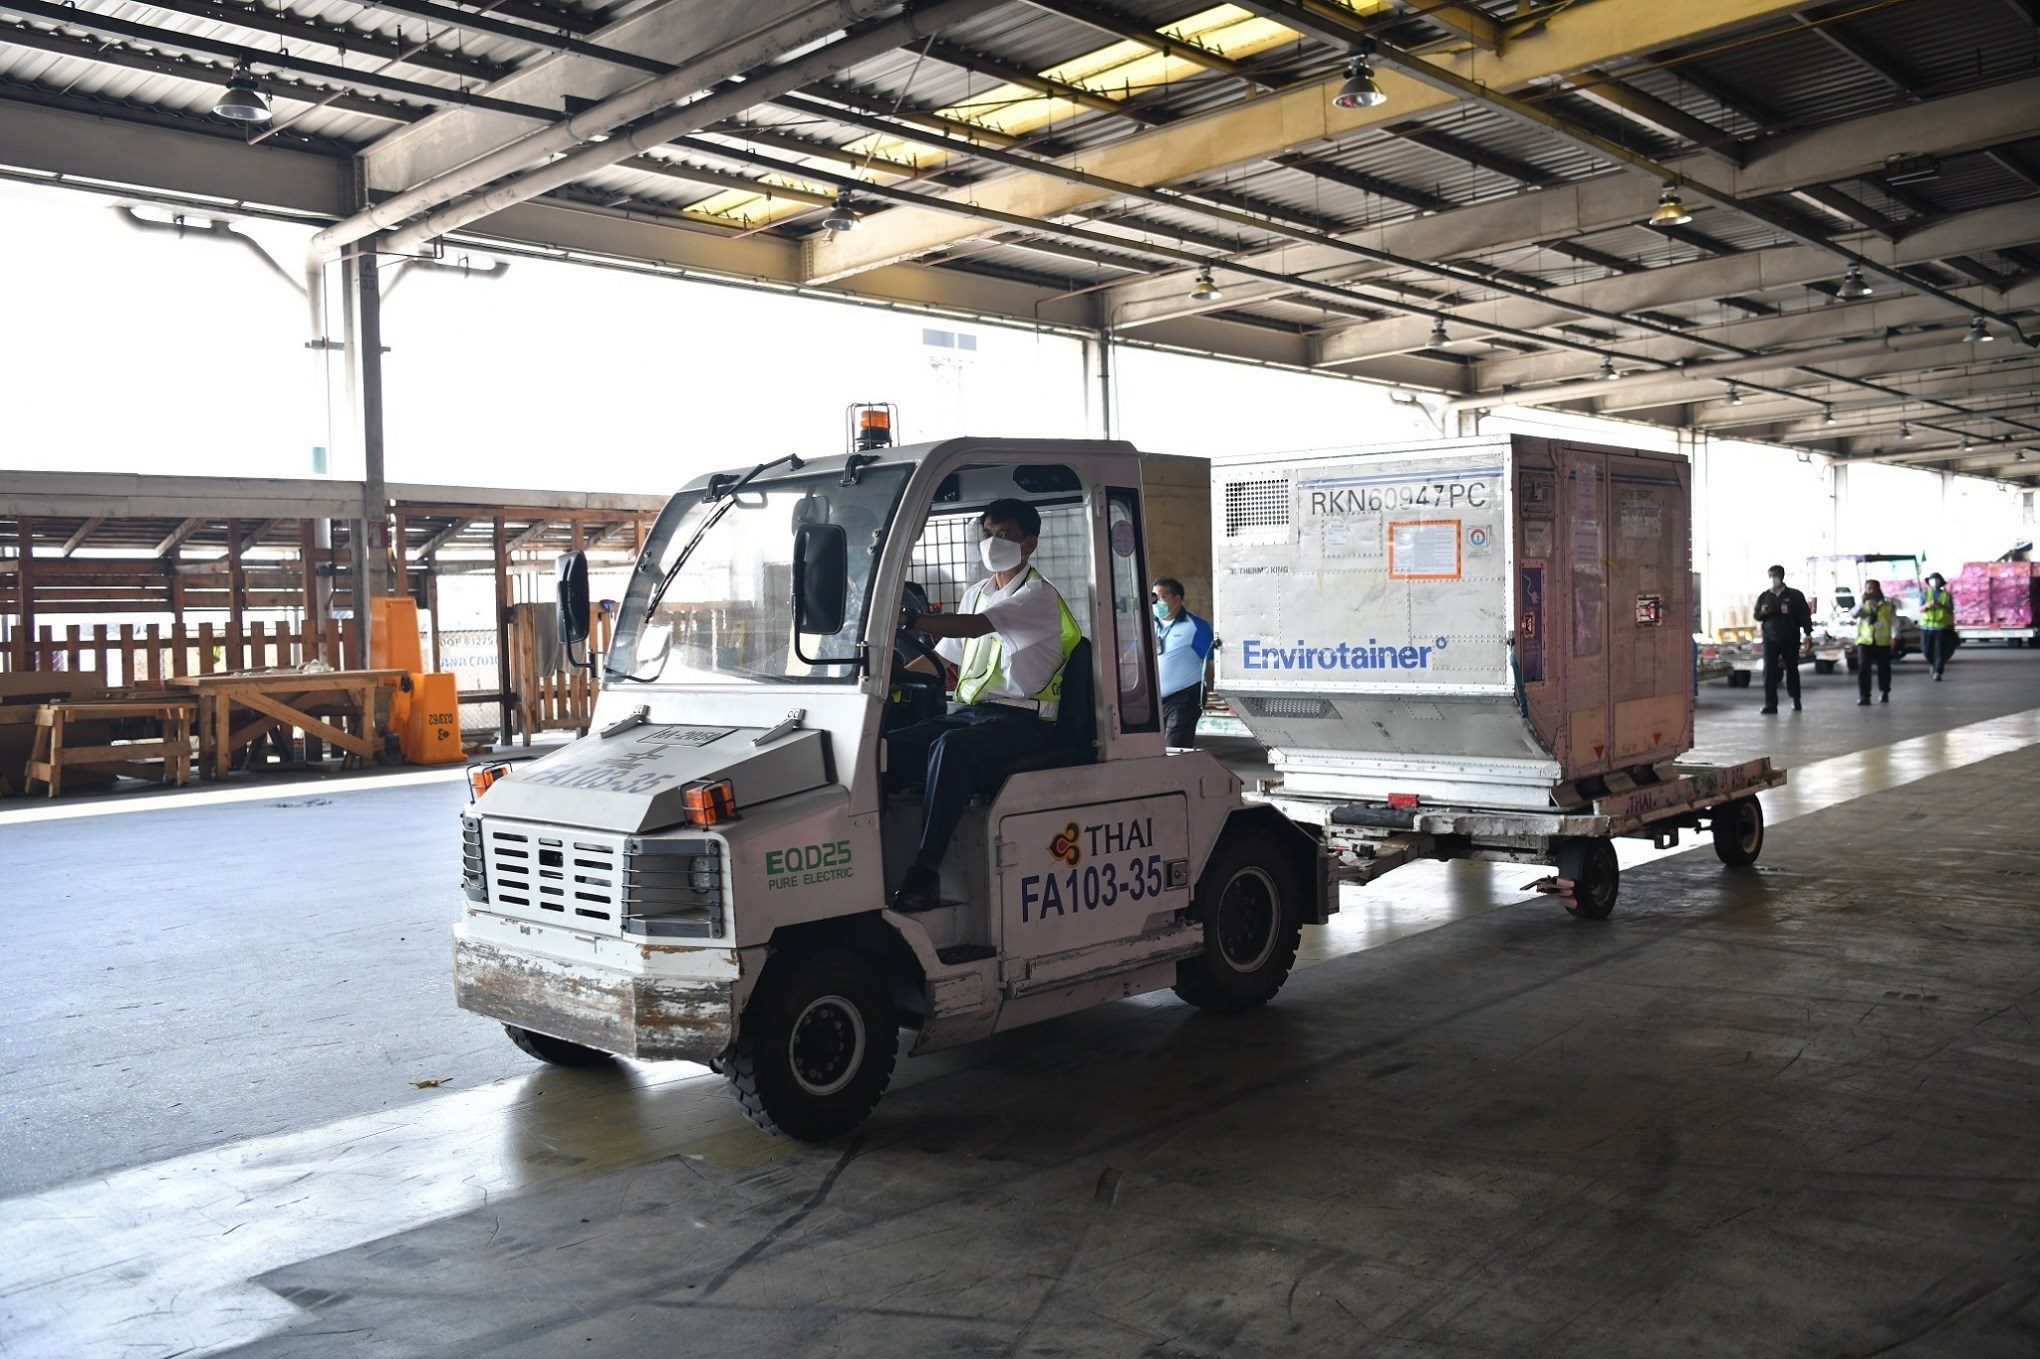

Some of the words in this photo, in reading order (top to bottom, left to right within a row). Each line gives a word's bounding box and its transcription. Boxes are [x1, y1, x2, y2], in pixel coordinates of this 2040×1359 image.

[1311, 482, 1486, 516] RKN60947PC
[1270, 566, 1289, 574] KING
[523, 765, 676, 794] FA103-35
[1084, 817, 1153, 856] THAI
[765, 840, 852, 875] EQD25
[768, 876, 797, 891] PURE
[804, 867, 853, 885] ELECTRIC
[1021, 854, 1162, 923] FA103-35
